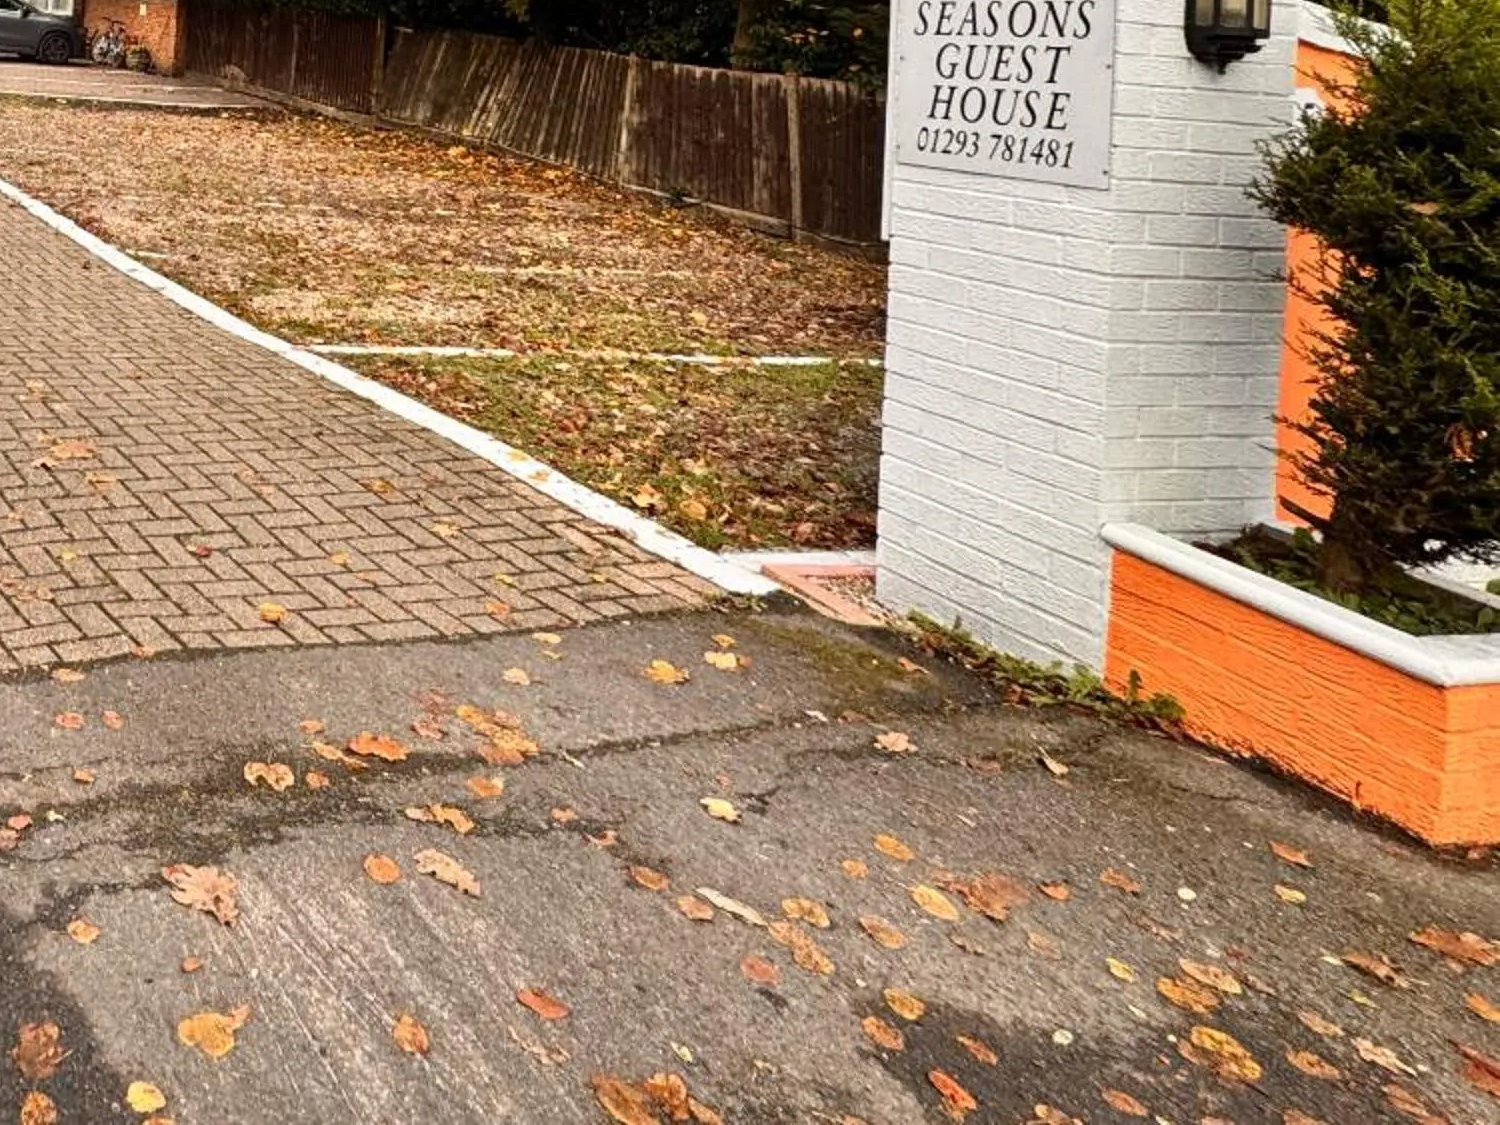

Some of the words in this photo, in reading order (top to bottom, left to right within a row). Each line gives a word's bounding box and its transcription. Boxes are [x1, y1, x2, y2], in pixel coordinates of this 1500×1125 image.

[935, 42, 1072, 84] GUEST
[926, 84, 1072, 130] HOUSE
[916, 126, 980, 158] 01293
[988, 133, 1075, 169] 781481
